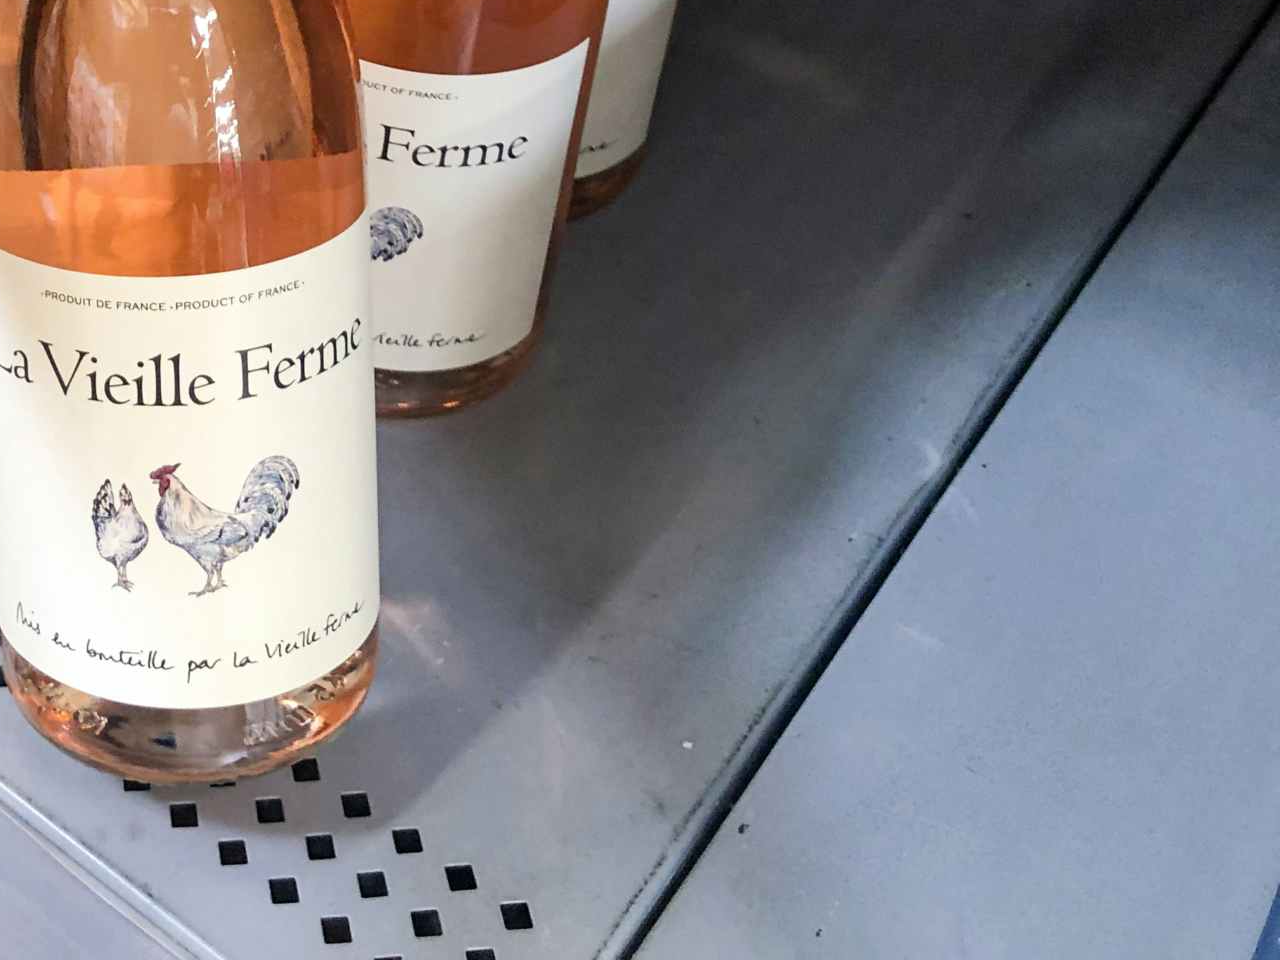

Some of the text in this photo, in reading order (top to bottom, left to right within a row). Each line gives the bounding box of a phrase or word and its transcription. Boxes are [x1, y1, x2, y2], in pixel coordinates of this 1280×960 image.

[389, 86, 405, 95] OF
[376, 123, 529, 169] Ferme
[95, 298, 112, 310] DE
[115, 300, 167, 312] FRANCE
[238, 293, 253, 305] OF
[37, 339, 217, 408] Vieille
[234, 317, 362, 401] Ferme
[86, 639, 175, 671] bouteille
[186, 657, 224, 685] par
[232, 651, 258, 669] la
[264, 628, 322, 660] Vieille
[323, 599, 365, 637] ferme
